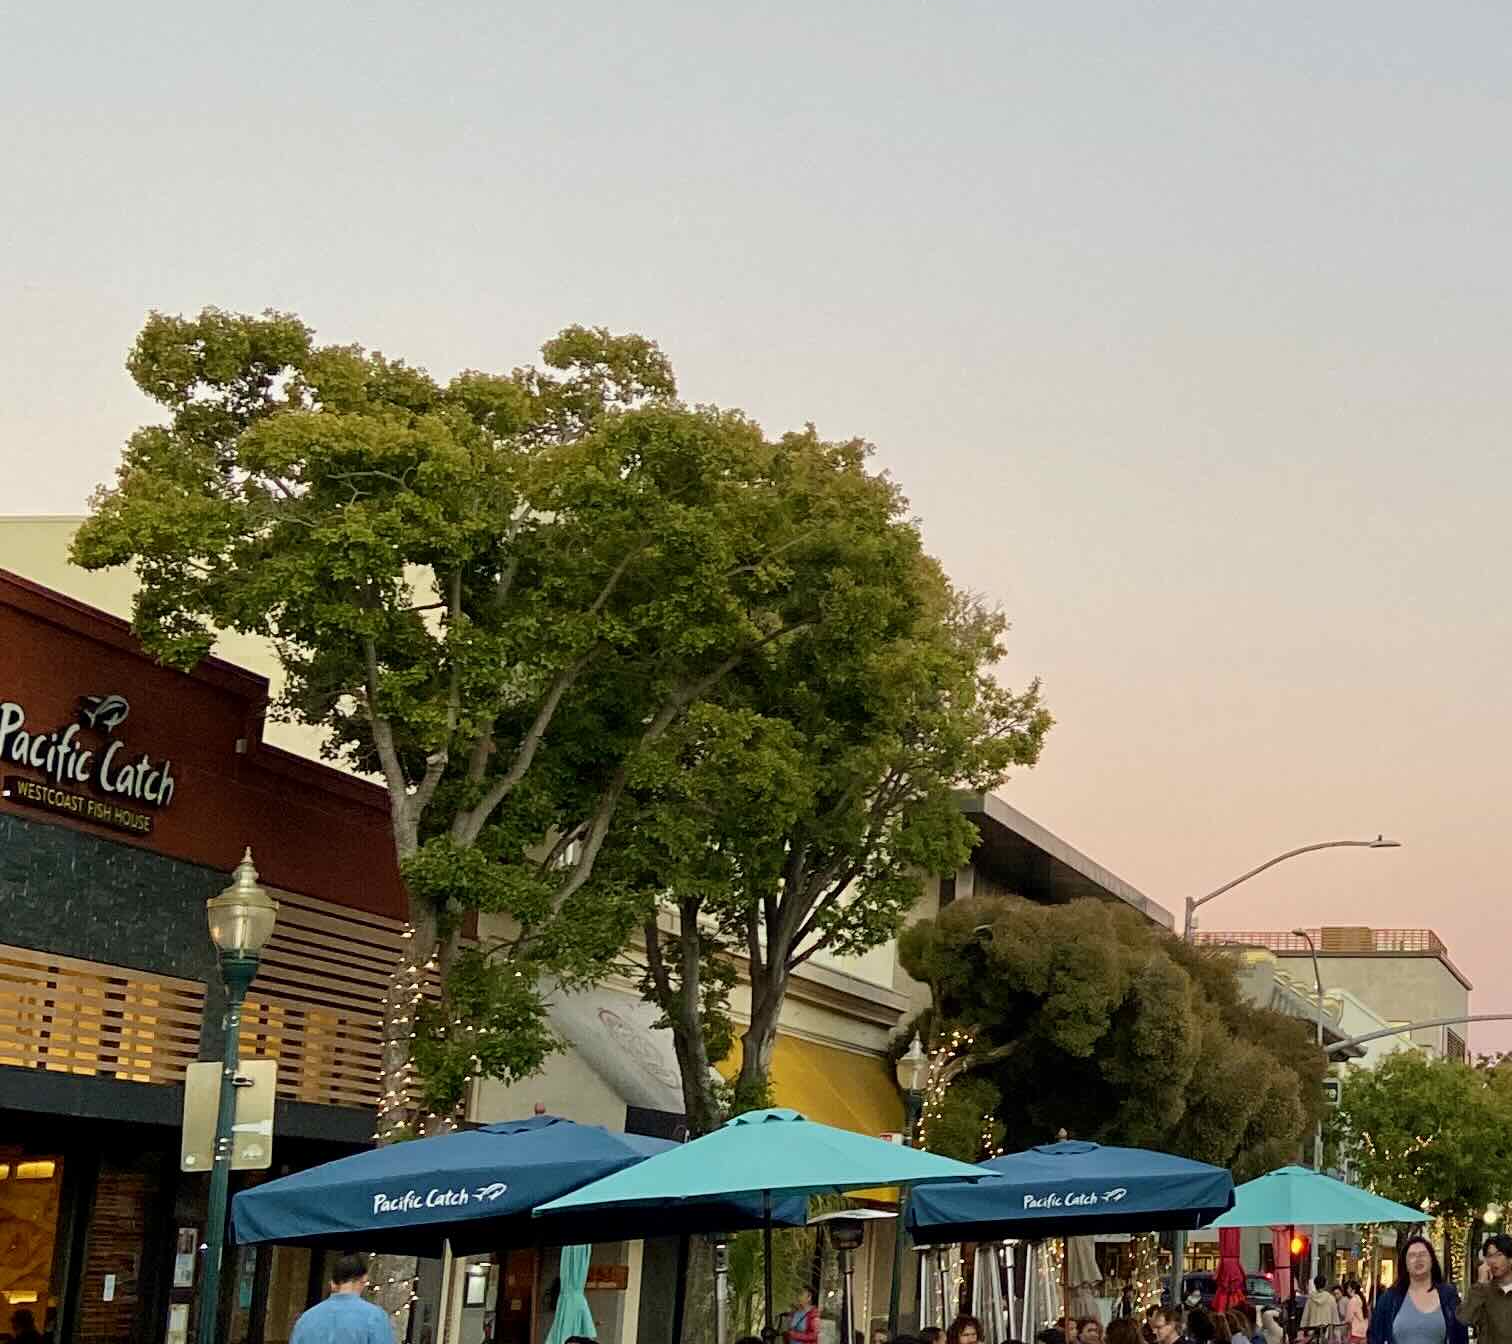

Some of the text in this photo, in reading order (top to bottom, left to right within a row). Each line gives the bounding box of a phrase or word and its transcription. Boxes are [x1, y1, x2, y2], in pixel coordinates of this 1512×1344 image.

[0, 702, 174, 805] Pacific Catch
[17, 780, 151, 832] WESTCOAST FISH HOUSE
[374, 1187, 468, 1215] Pacific Catch
[1024, 1192, 1098, 1210] Pacific Catch
